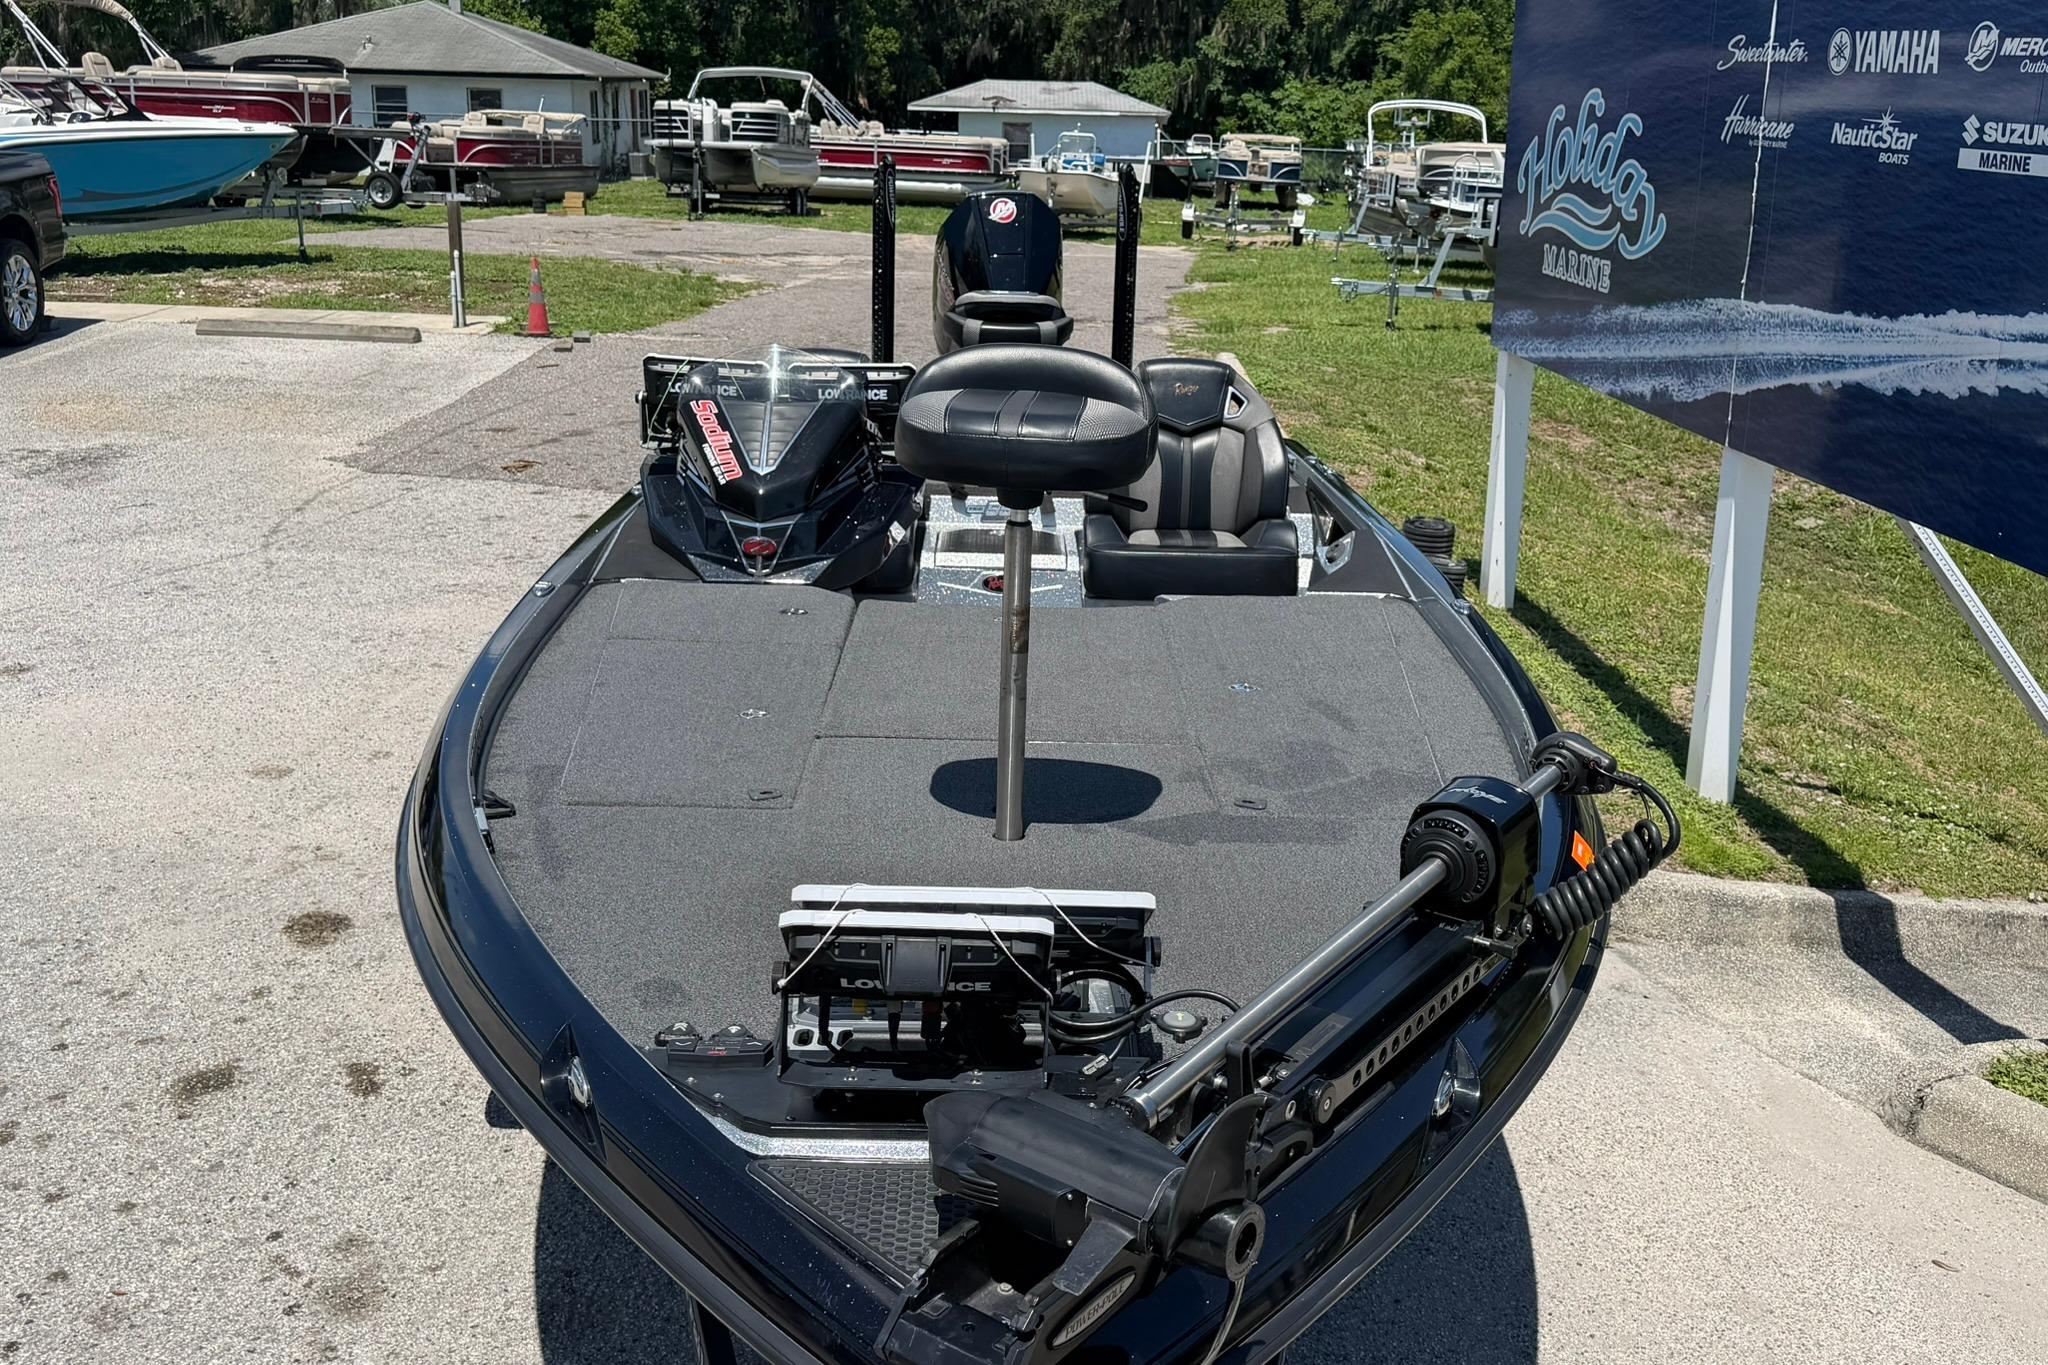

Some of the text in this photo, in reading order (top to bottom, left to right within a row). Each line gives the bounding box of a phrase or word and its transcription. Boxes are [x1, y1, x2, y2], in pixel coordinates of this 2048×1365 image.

[1717, 34, 1808, 70] Sweetwater
[1854, 30, 1940, 74] YAMAHA
[1721, 94, 1794, 144] Hurricane
[1831, 118, 1918, 151] NauticStar
[1518, 87, 1667, 260] Holiday
[1878, 152, 1909, 165] BOATS
[1979, 152, 2031, 172] MARINE
[1542, 243, 1611, 293] MARINE
[690, 400, 743, 481] Sodium
